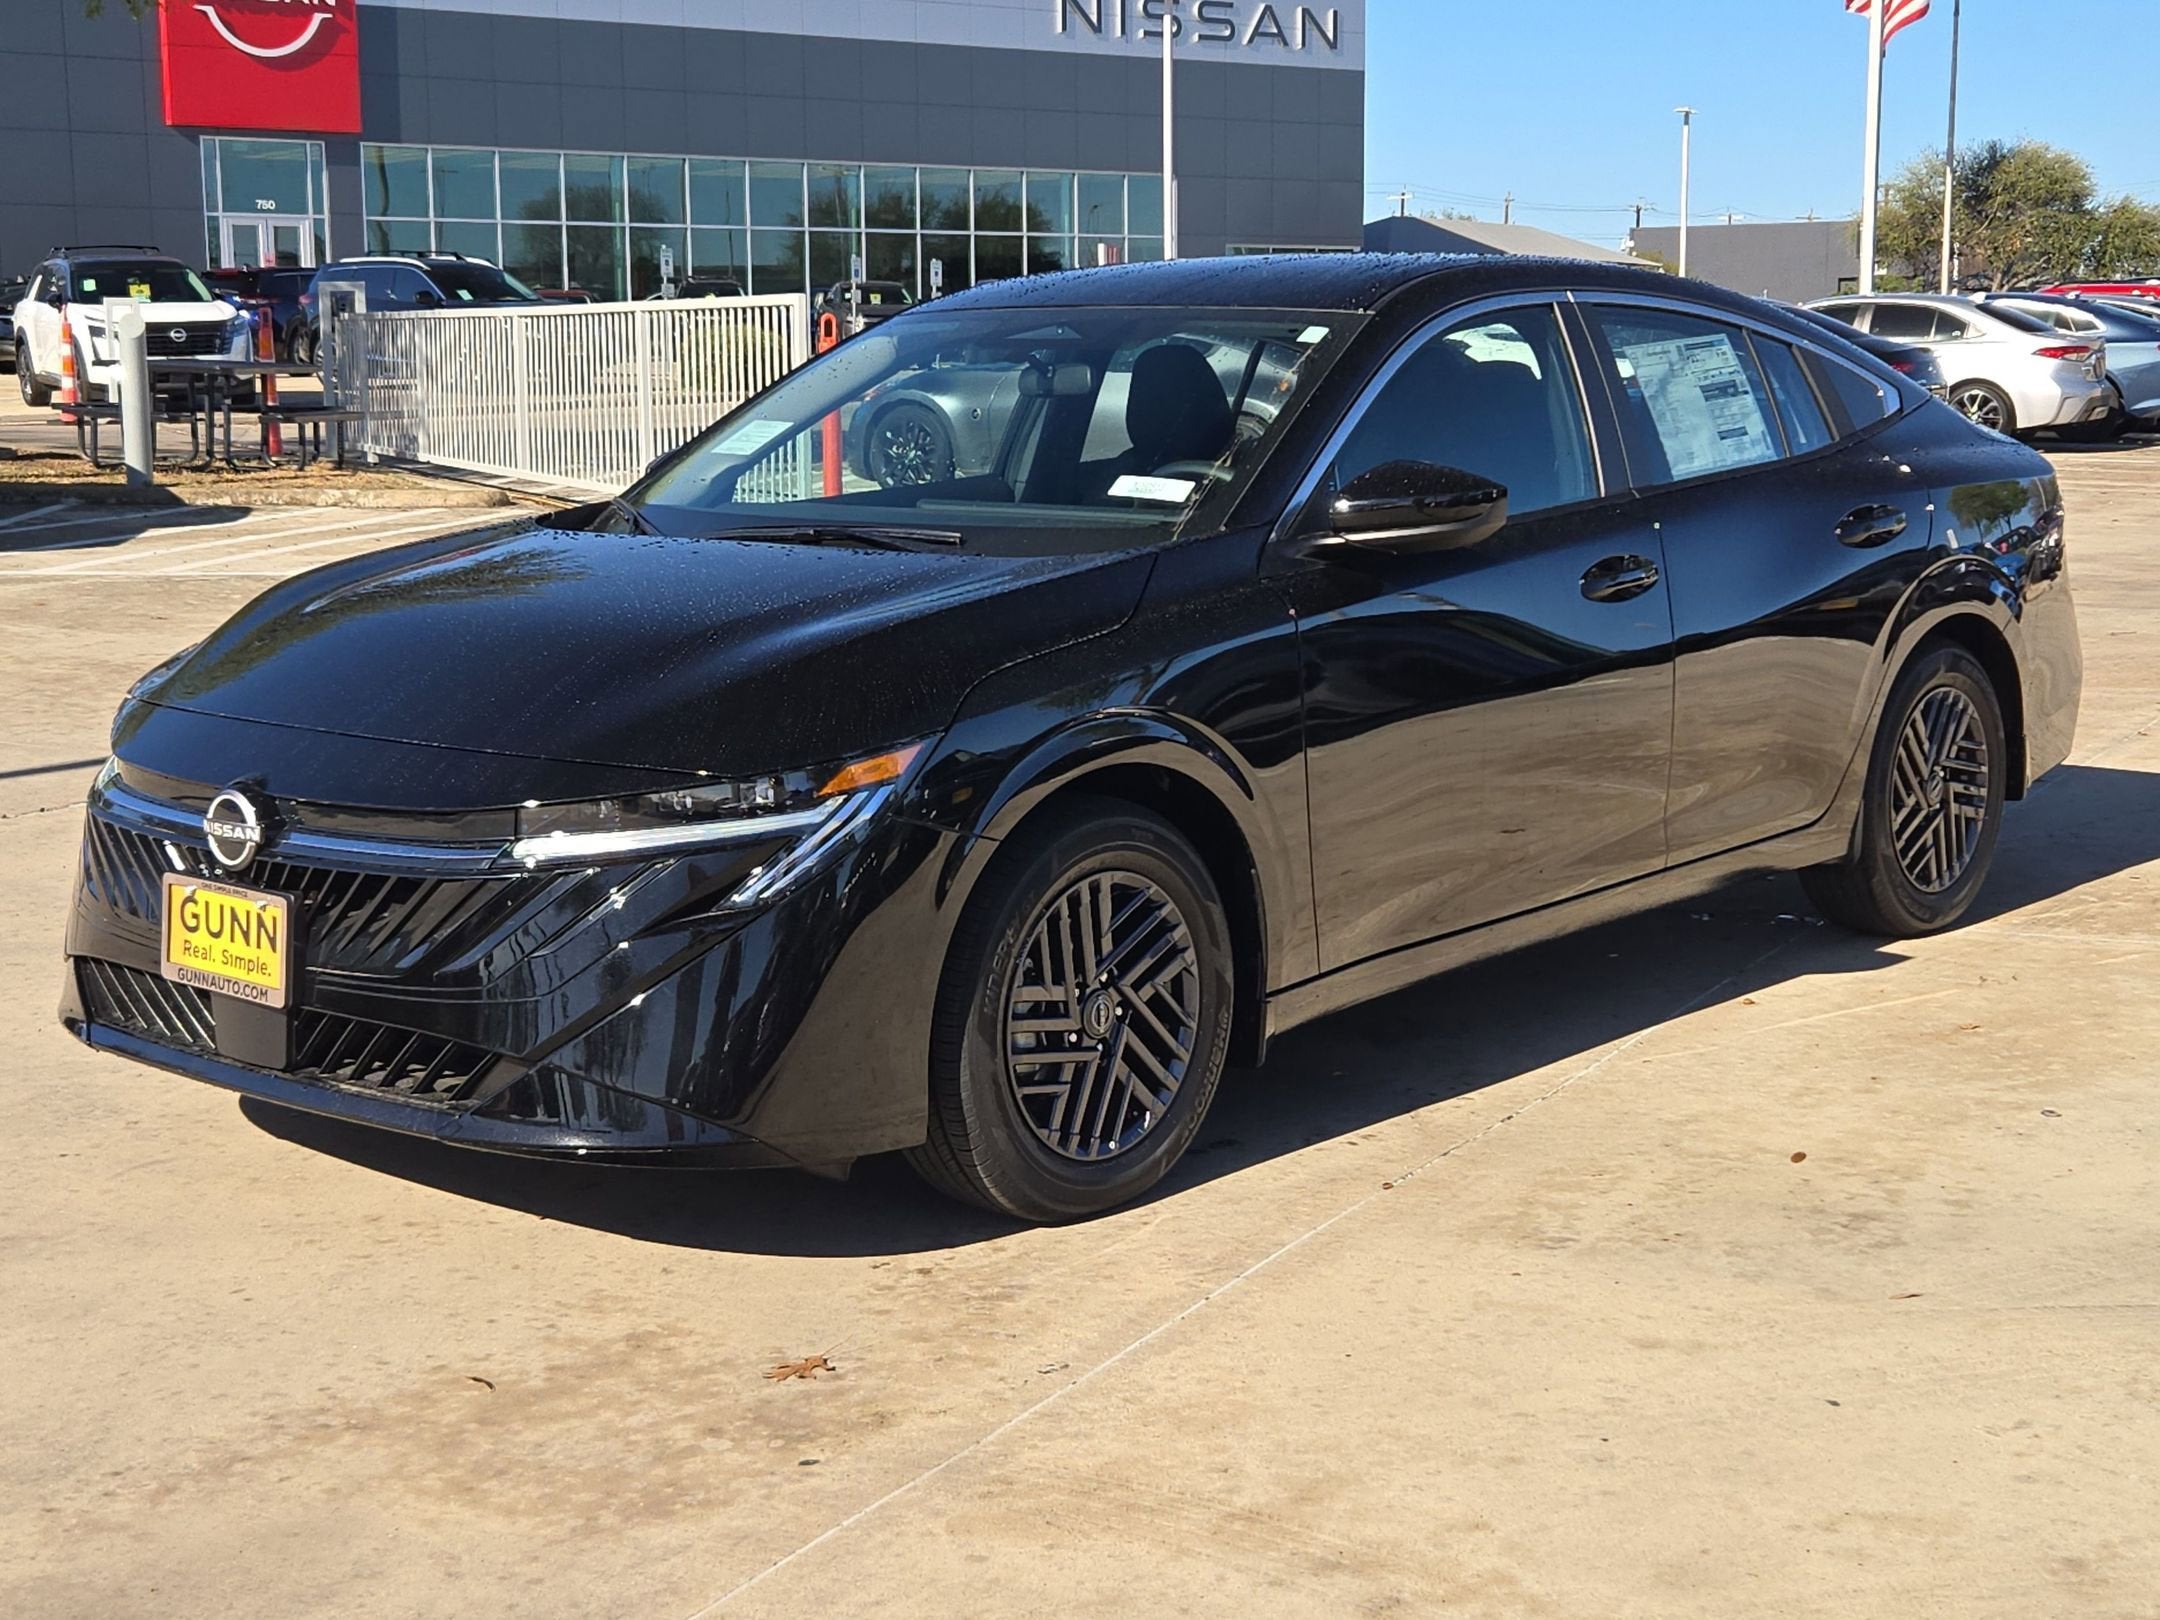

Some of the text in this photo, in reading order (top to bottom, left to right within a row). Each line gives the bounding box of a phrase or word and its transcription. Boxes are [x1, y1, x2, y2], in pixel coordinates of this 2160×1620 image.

[1057, 0, 1338, 50] NISSAN
[255, 199, 276, 210] 750
[203, 819, 261, 843] NISSAN
[180, 895, 277, 953] GUNN
[183, 939, 271, 977] Real. Simple.
[177, 967, 268, 1002] GUNNAUTO.COM
